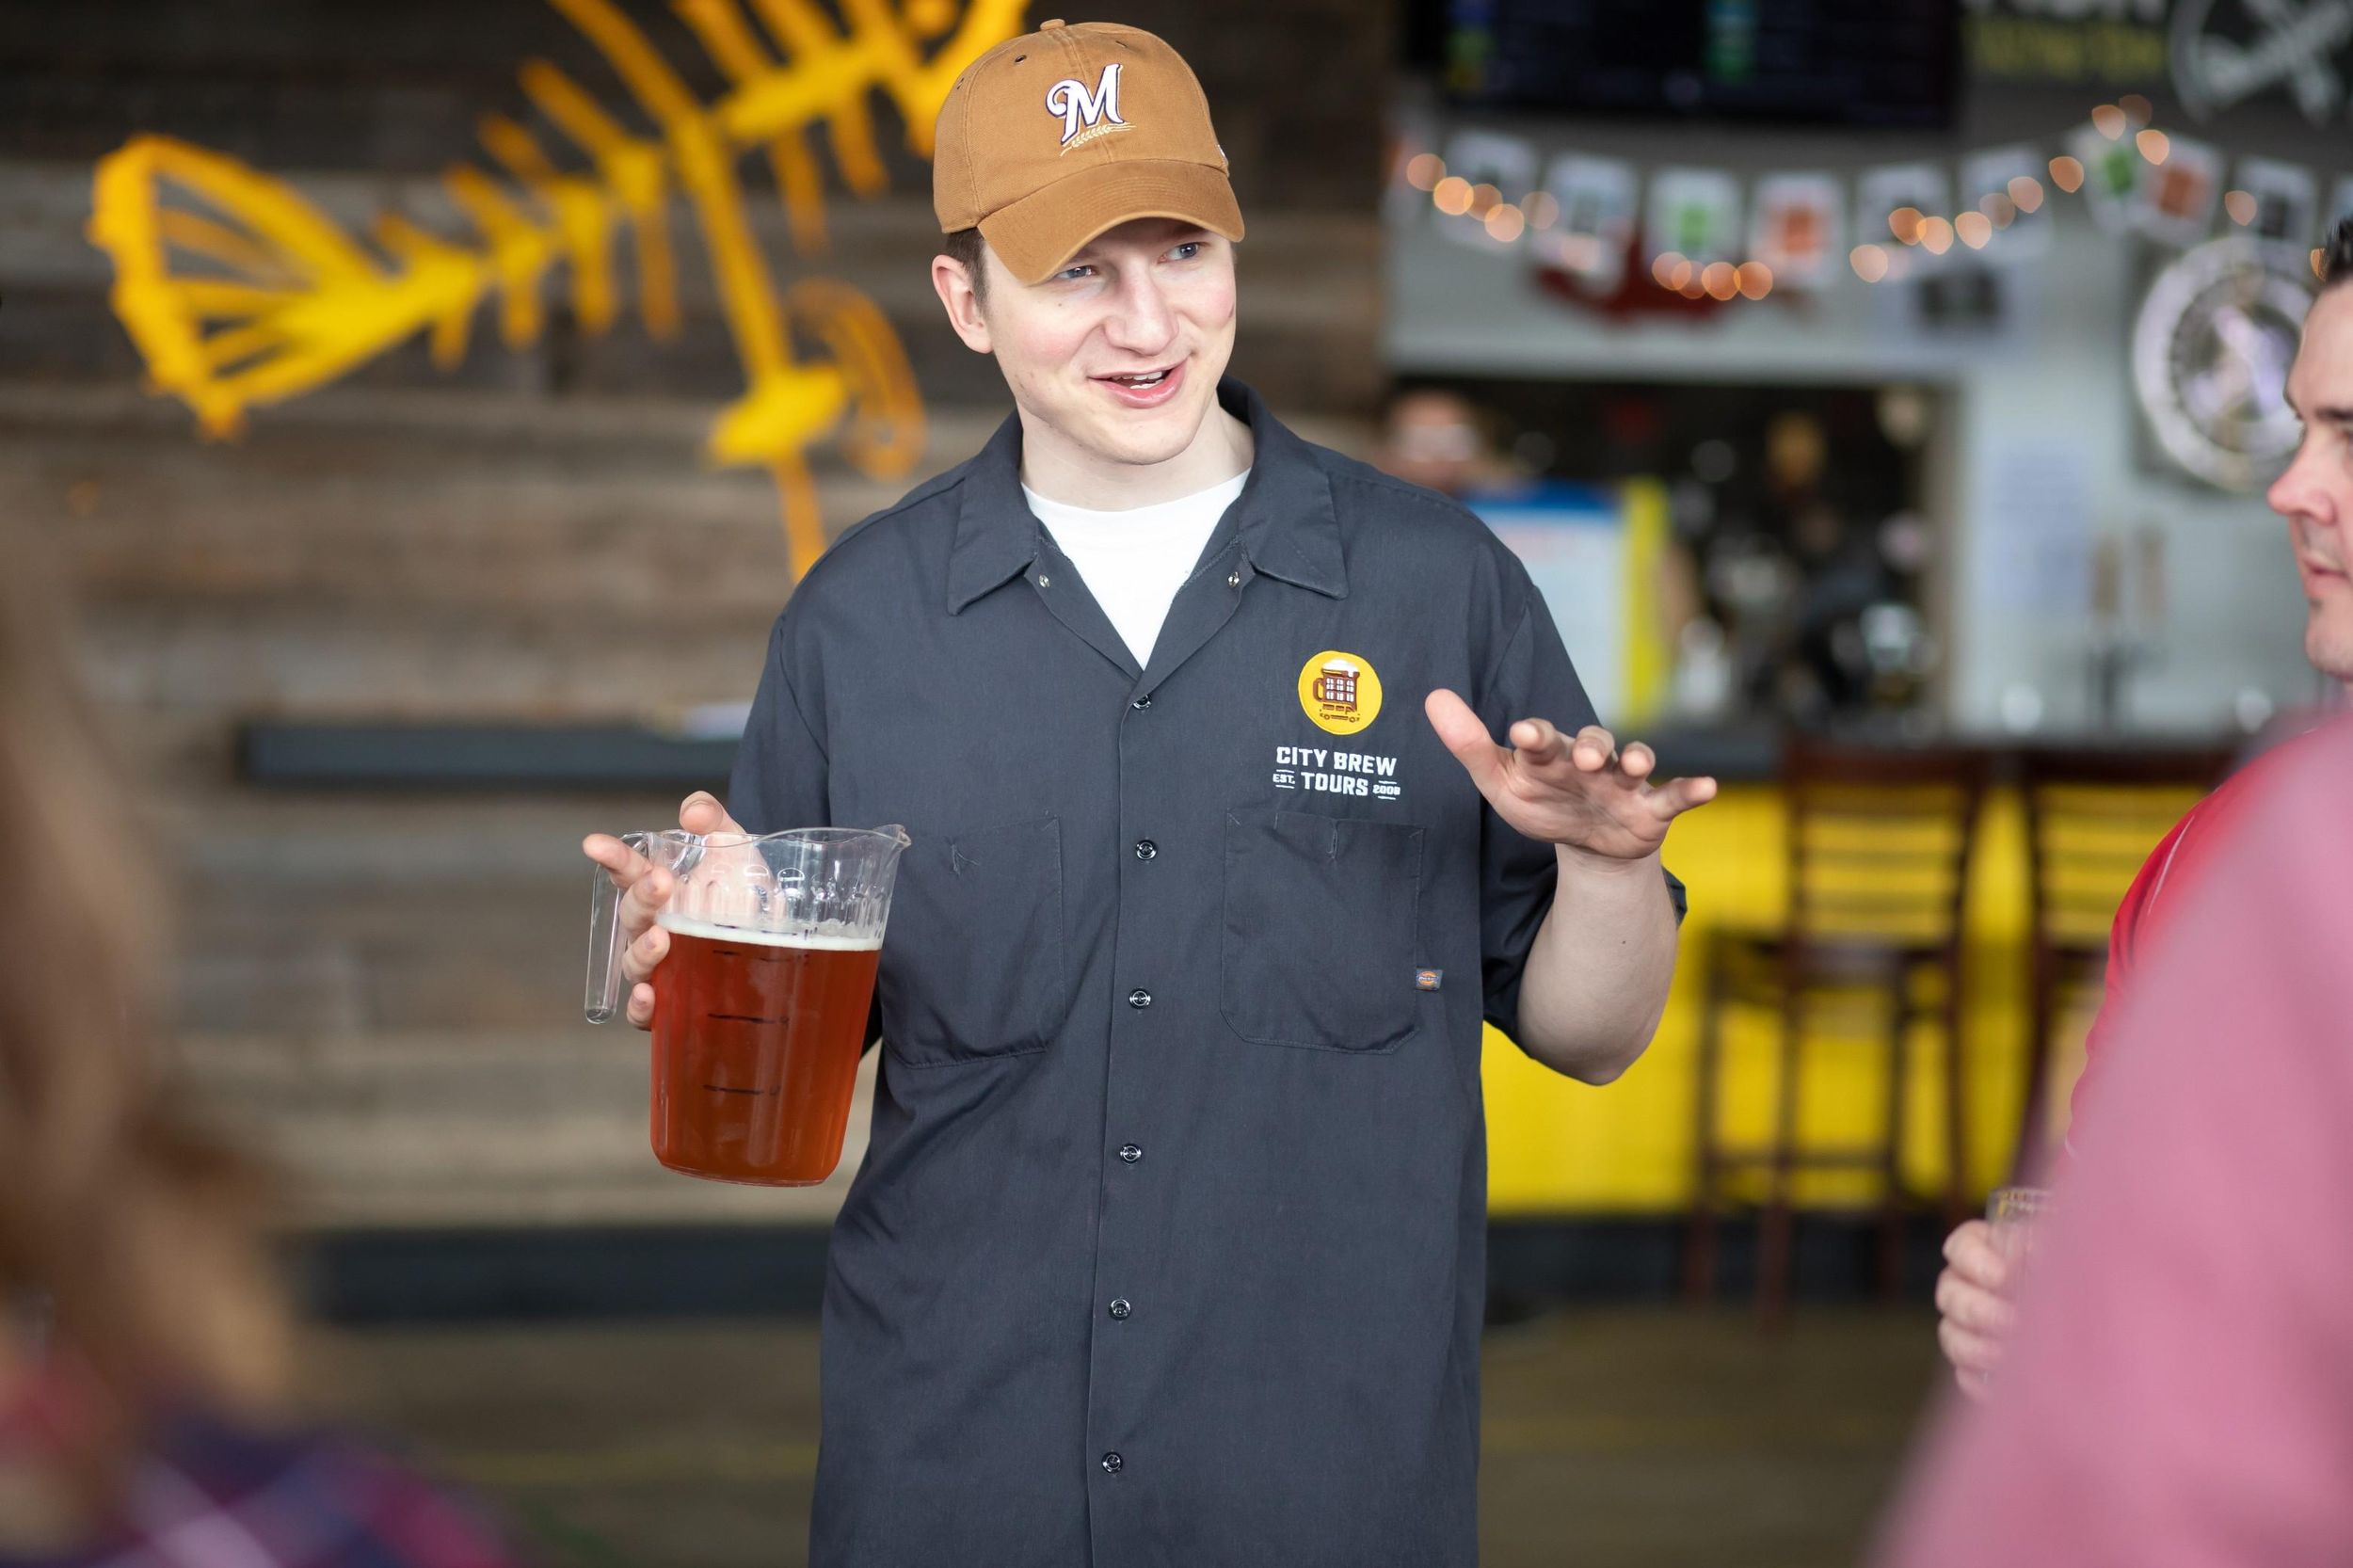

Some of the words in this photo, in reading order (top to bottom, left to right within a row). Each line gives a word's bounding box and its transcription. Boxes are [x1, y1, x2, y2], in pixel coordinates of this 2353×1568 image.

[1046, 63, 1124, 146] M
[1276, 746, 1328, 767] CITY
[1333, 751, 1397, 776] BREW
[1273, 774, 1295, 785] EST.
[1301, 772, 1369, 796] TOURS
